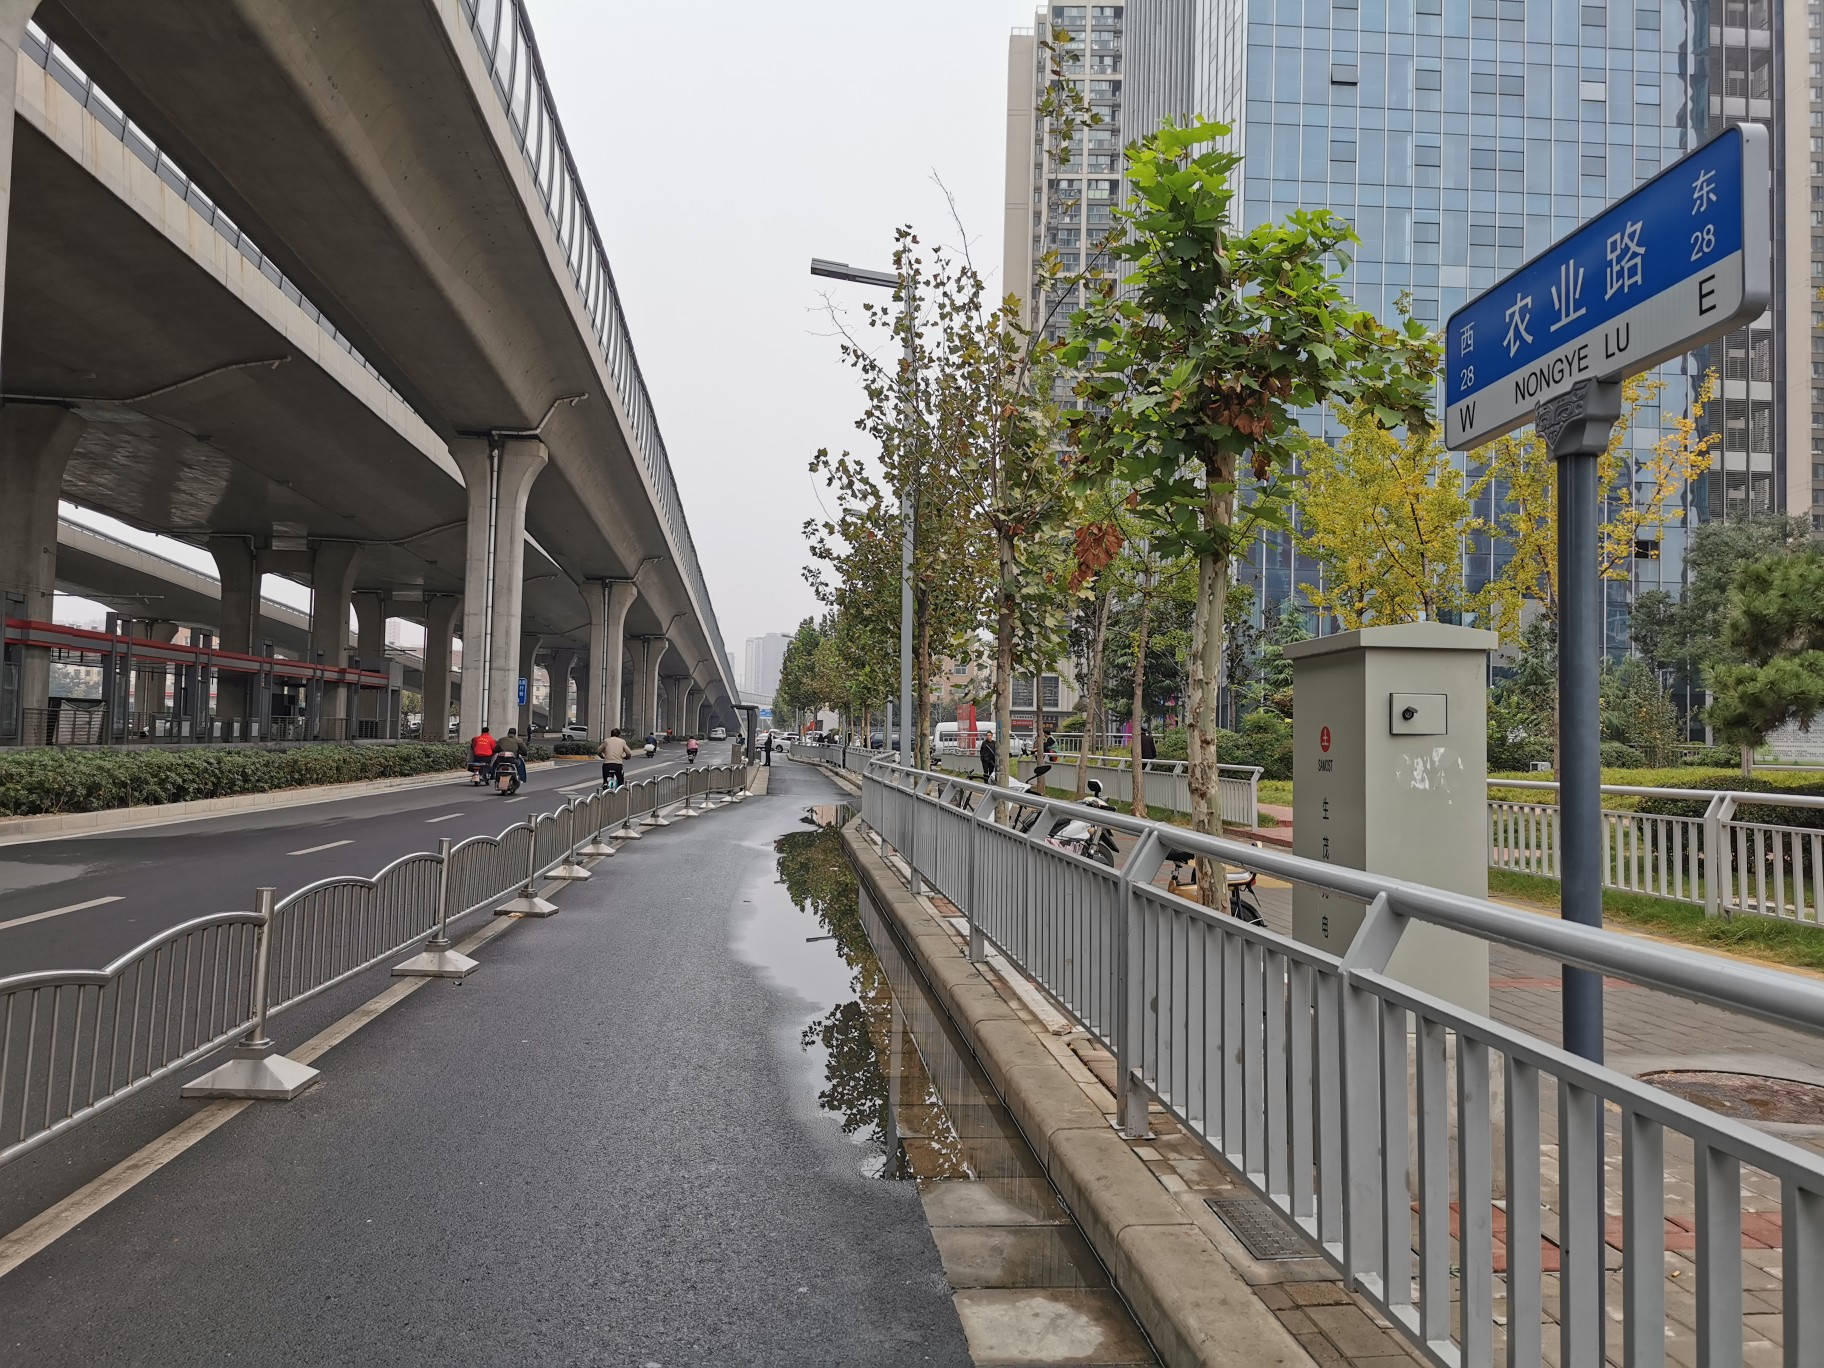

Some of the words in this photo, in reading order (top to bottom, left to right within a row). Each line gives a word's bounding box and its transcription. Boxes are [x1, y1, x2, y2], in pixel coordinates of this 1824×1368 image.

[1691, 169, 1717, 216] 东
[1690, 224, 1715, 262] 28
[1502, 219, 1646, 359] 农业路
[1459, 401, 1476, 432] W
[1514, 344, 1589, 404] NONGYE
[1604, 322, 1630, 360] LU
[1699, 274, 1717, 316] E
[1460, 321, 1474, 357] 西
[1460, 366, 1474, 391] 28
